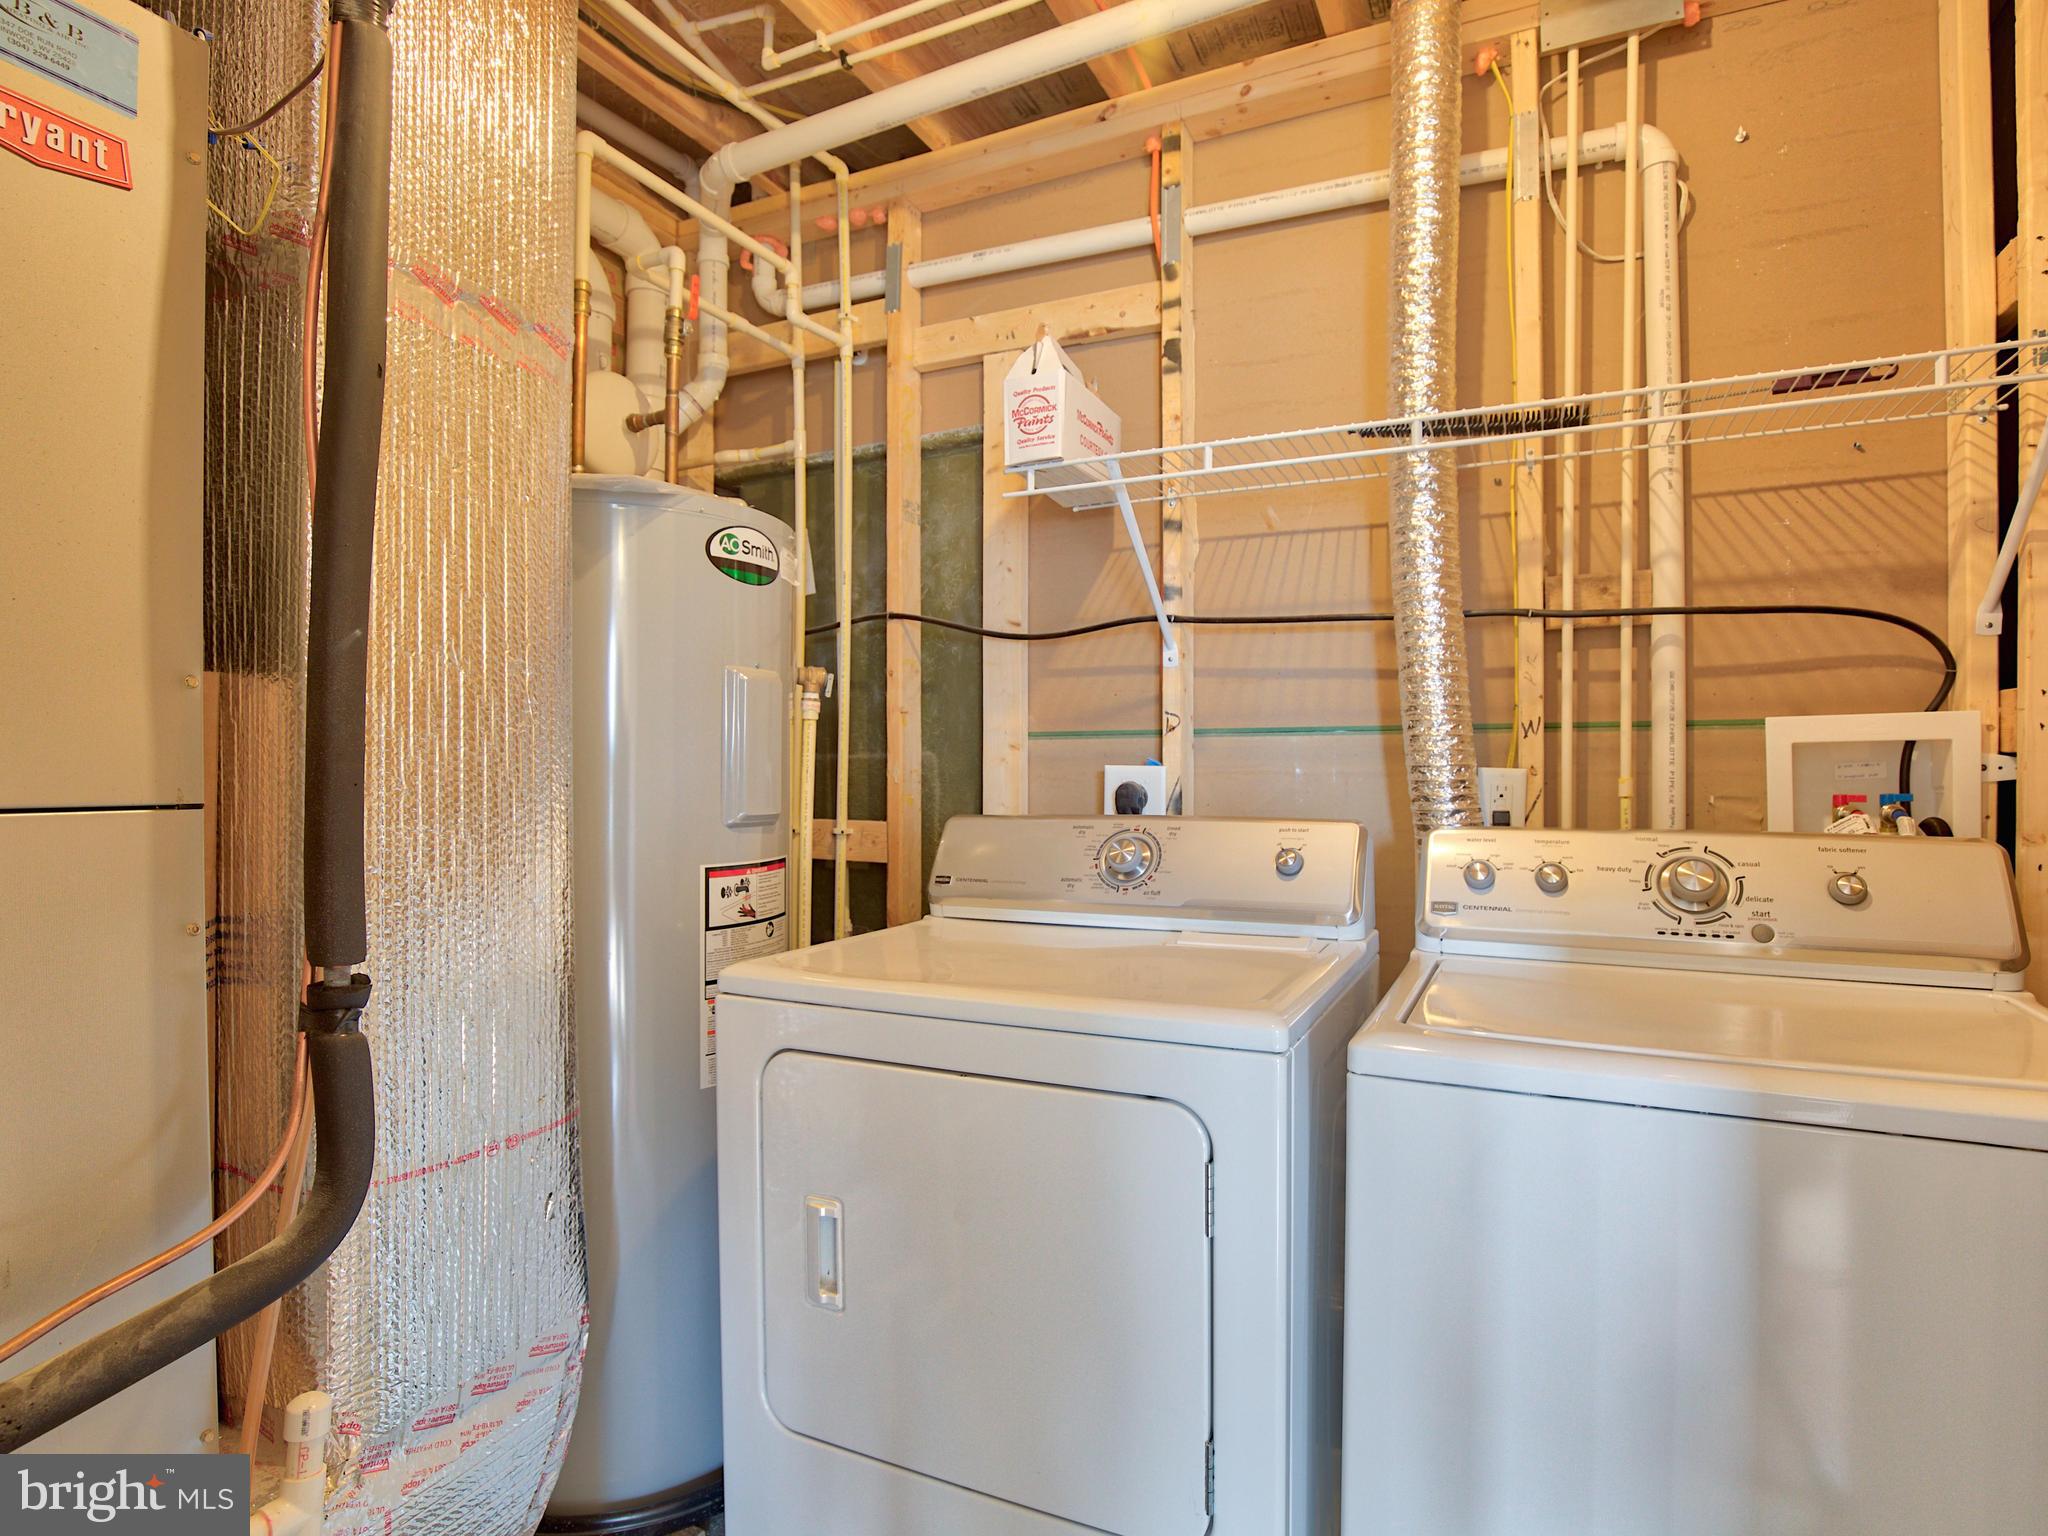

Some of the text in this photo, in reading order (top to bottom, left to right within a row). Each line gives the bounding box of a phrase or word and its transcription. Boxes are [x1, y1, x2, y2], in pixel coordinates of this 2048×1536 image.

[38, 12, 58, 29] &
[66, 23, 84, 41] B
[7, 36, 30, 53] (304)
[56, 44, 79, 60] ROAD
[0, 101, 109, 171] ryant
[1012, 385, 1057, 398] Quality Products
[1012, 415, 1055, 429] Paints
[1016, 437, 1035, 446] Quality
[1036, 434, 1056, 442] Service
[741, 539, 775, 562] Smith
[1596, 865, 1632, 874] heavy duty
[1737, 860, 1761, 868] casual
[1745, 895, 1774, 903] delicate
[1462, 903, 1513, 913] CENTENNIAL
[1751, 910, 1771, 919] start
